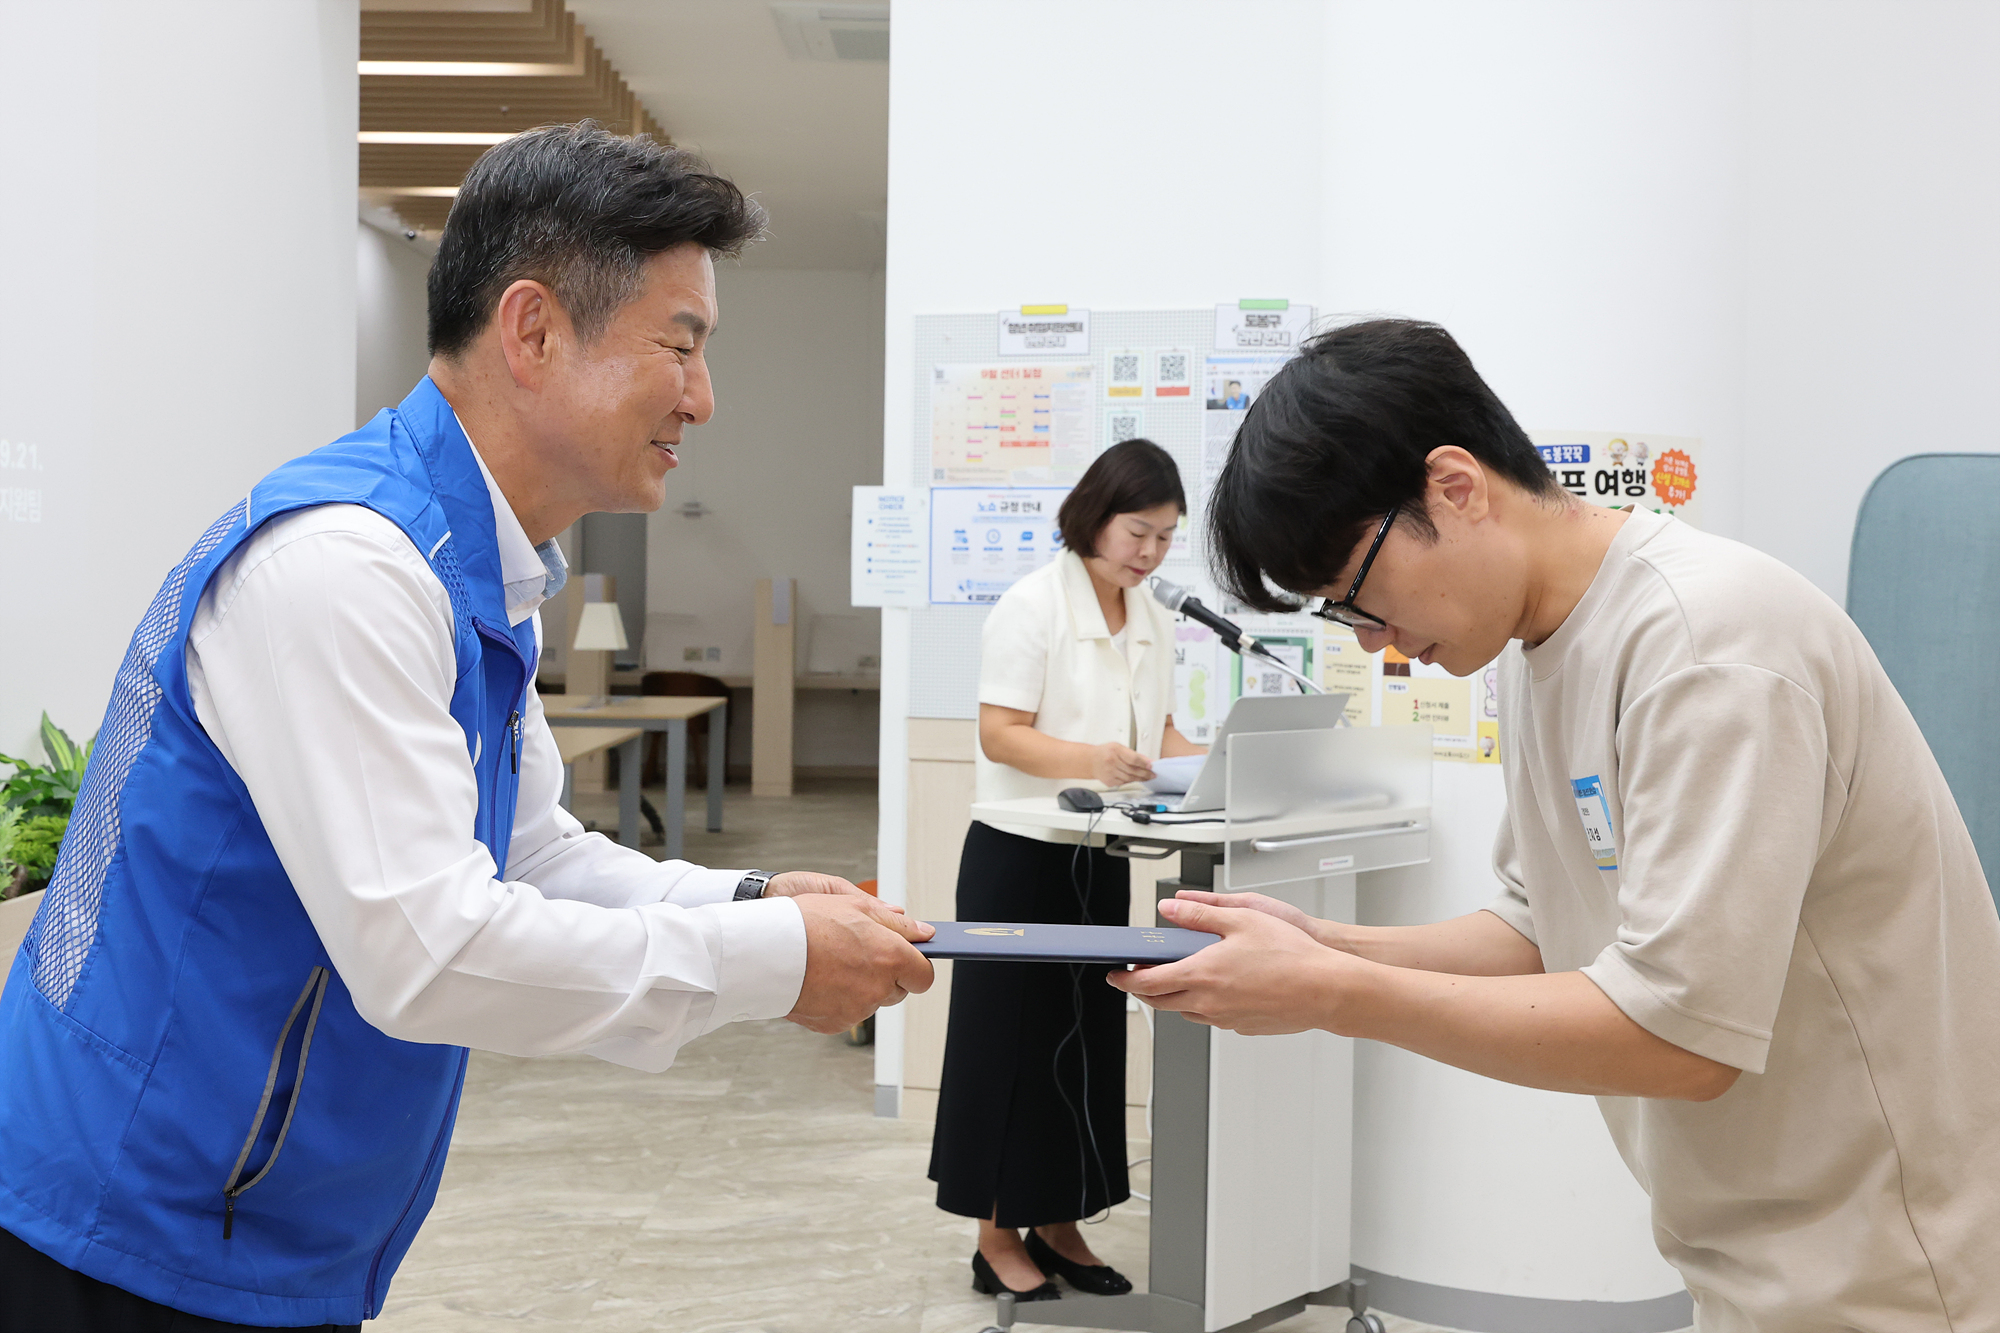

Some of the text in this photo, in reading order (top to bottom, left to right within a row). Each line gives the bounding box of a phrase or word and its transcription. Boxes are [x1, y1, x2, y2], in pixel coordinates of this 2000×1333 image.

[1245, 314, 1281, 328] 도봉구
[1594, 469, 1647, 497] 여행
[1000, 501, 1019, 513] 규정
[1021, 501, 1042, 513] 안내
[1413, 698, 1419, 710] 1
[1412, 711, 1420, 722] 2
